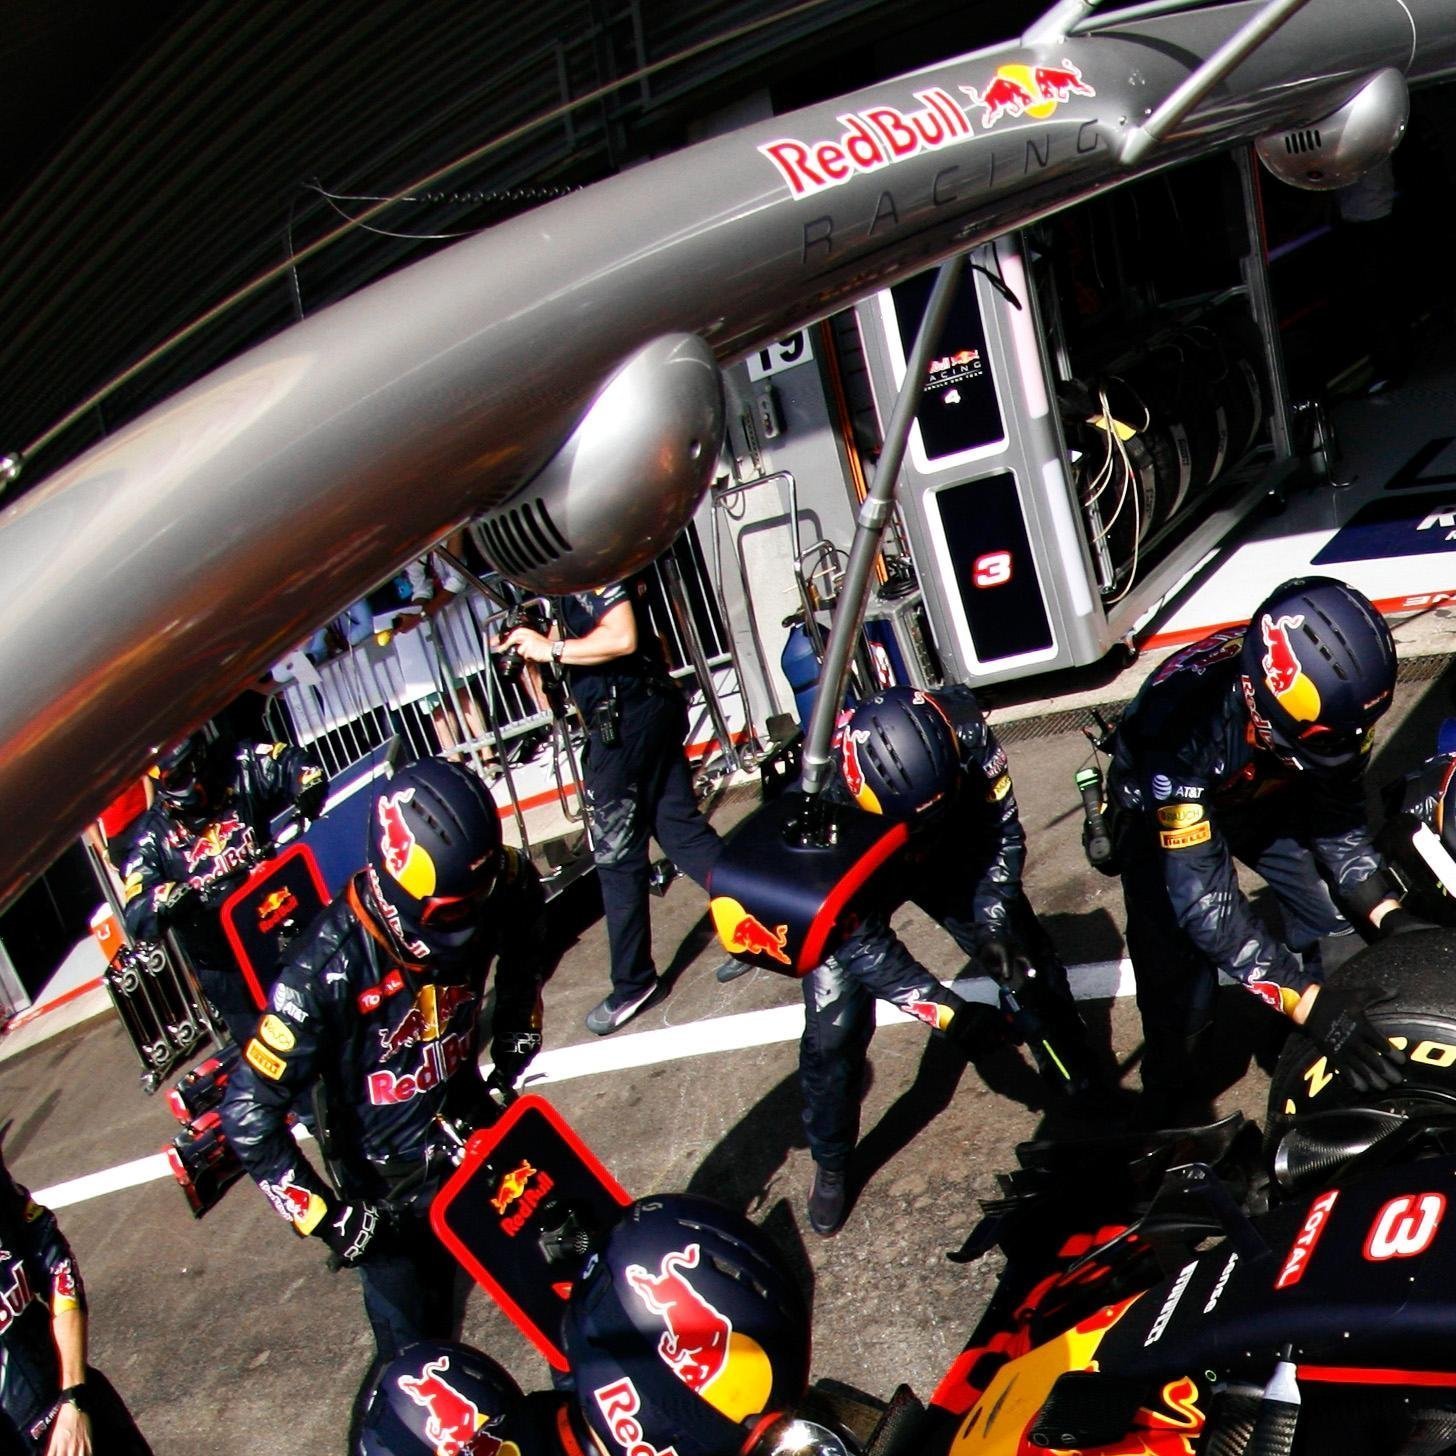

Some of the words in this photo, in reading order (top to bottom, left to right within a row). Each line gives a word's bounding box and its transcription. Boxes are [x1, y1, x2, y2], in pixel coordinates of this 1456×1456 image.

[802, 119, 1099, 263] RACING
[945, 388, 961, 403] 4
[973, 551, 1014, 590] 3
[1175, 786, 1204, 798] AT&T
[1277, 1190, 1339, 1288] TOTAL
[1364, 1194, 1446, 1261] 3
